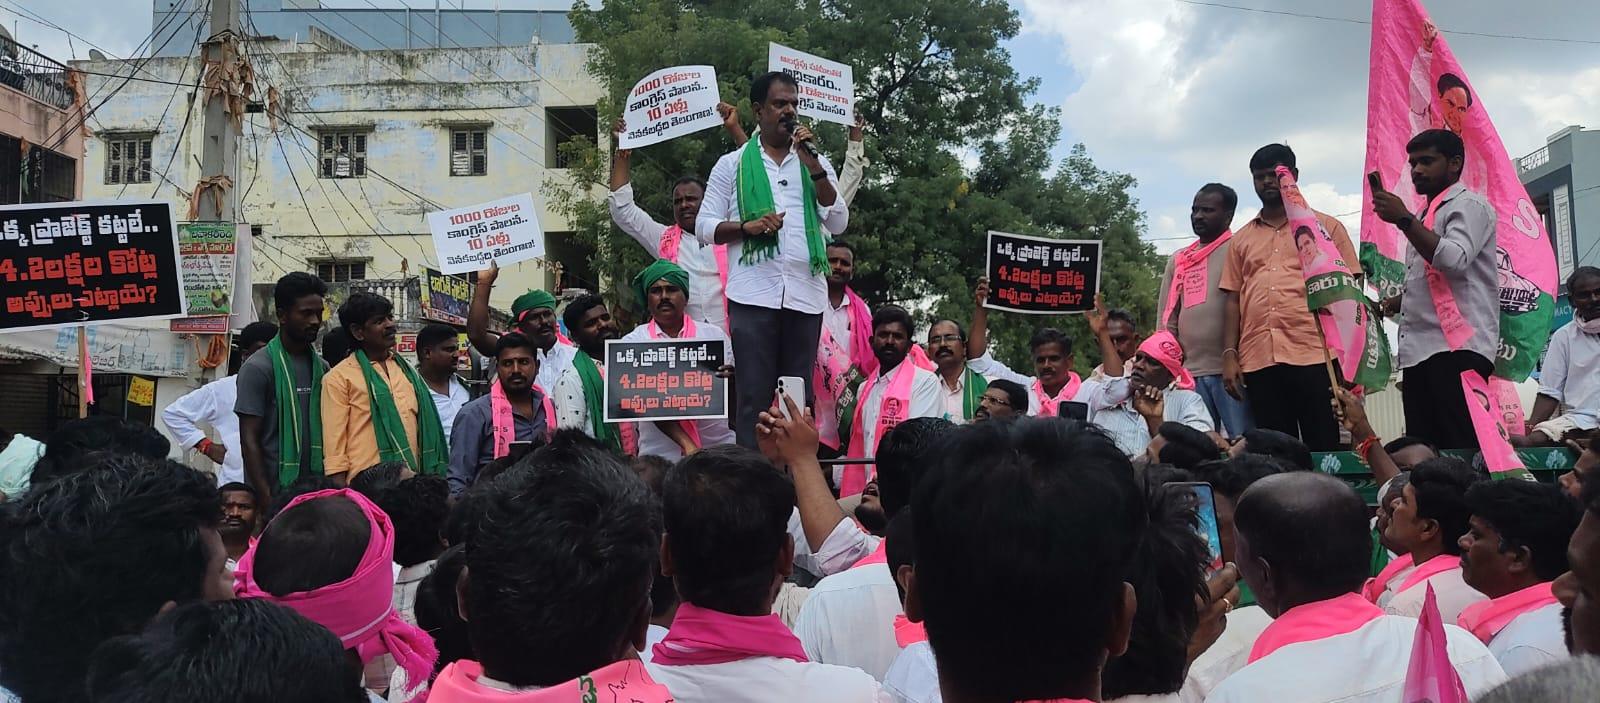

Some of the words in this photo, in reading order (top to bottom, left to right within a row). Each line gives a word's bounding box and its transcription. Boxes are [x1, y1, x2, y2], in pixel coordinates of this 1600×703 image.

[634, 78, 661, 97] 1000
[662, 71, 701, 86] రోజుల
[629, 88, 666, 112] కాంగ్రెస్
[668, 81, 708, 98] పాలన..
[805, 86, 849, 105] రోజులుగా
[647, 107, 662, 122] 10
[671, 106, 714, 127] తెలంగాణ!
[816, 101, 846, 116] మోసం
[449, 211, 481, 226] 1000
[483, 203, 520, 219] రోజుల
[31, 213, 92, 246] ప్రాజెక్ట్
[98, 209, 158, 244] కట్టలే..
[447, 222, 488, 239] కాంగ్రెస్
[490, 214, 528, 231] పాలన..
[466, 237, 483, 250] 10
[493, 239, 536, 258] తెలంగాణ!
[997, 243, 1015, 260] ఒక్క
[0, 252, 103, 287] 4.2లక్షల
[108, 248, 158, 280] కోట్ల
[1056, 270, 1084, 290] కోట్ల
[6, 291, 74, 318] అప్పులు
[998, 288, 1032, 305] అప్పులు
[616, 349, 640, 367] ఒక్క
[684, 371, 713, 391] కోట్ల
[621, 395, 659, 413] అప్పులు
[881, 418, 902, 426] BR
